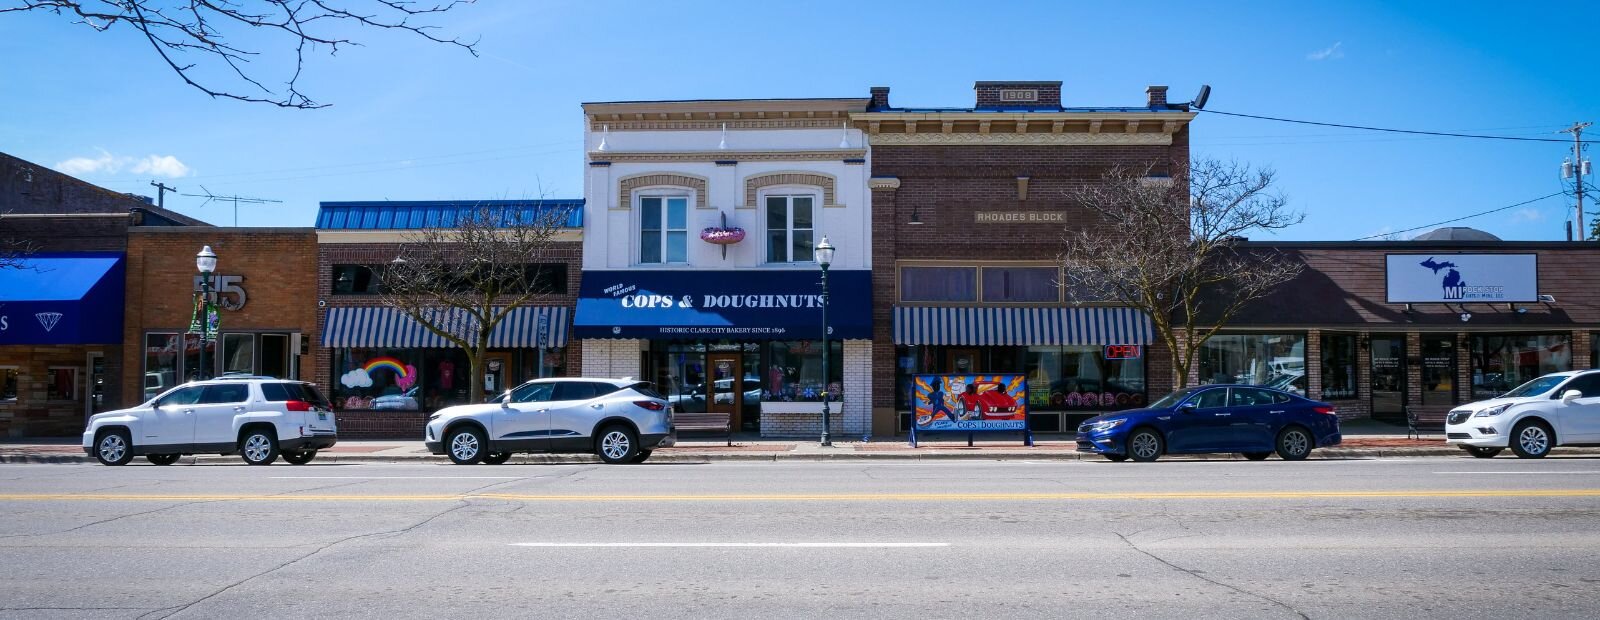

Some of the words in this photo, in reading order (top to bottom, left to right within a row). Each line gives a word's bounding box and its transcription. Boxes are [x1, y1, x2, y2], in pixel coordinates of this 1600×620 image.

[1005, 91, 1032, 99] 1908
[977, 213, 1026, 221] RHOADES
[1029, 213, 1064, 221] BLOCK
[603, 283, 624, 295] WORLD
[613, 284, 636, 297] FAMOUS
[1445, 286, 1463, 299] MI
[621, 294, 673, 308] COPS
[678, 294, 693, 308] &
[703, 294, 828, 308] DOUGHNUTS
[1107, 345, 1140, 358] OPEN
